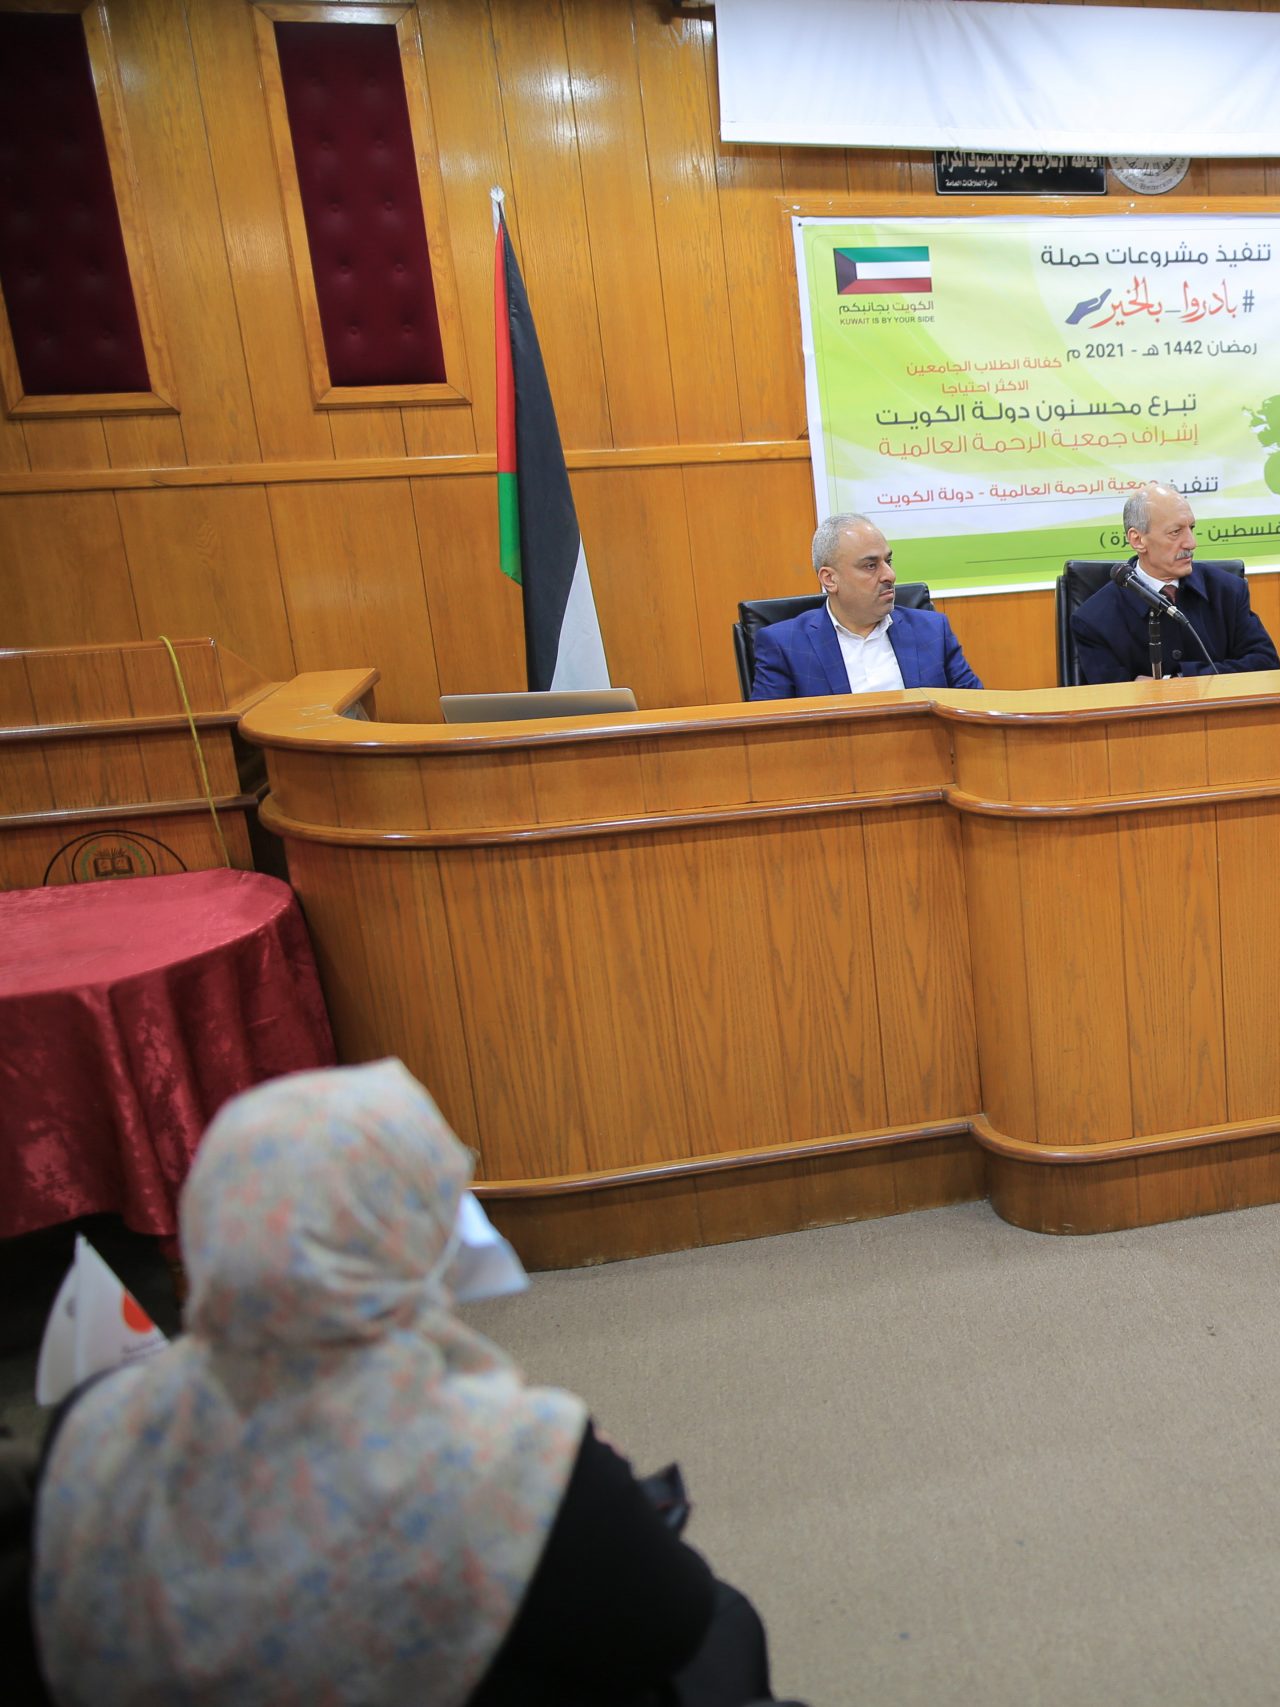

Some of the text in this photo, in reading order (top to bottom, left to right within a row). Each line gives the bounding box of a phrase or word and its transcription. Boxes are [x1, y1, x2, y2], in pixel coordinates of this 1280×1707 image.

[1041, 241, 1272, 268] تنفيذ مشروعات حملة
[839, 300, 934, 315] الكويت بجانبكم
[840, 318, 870, 326] KUWAIT
[893, 316, 915, 324] YOUR
[1066, 348, 1081, 362] م
[1085, 343, 1125, 359] 2021
[1163, 340, 1203, 356] 1442
[1207, 340, 1258, 357] رمضان
[906, 357, 1062, 376] كفالة الطلاب الجامعين
[941, 382, 990, 395] احتياجا
[875, 394, 1198, 430] تبرع محسنون دولة الكويت
[878, 421, 1199, 460] إشراف جمعية الرحمة العالمية
[989, 482, 1051, 501] العالمية
[1055, 478, 1104, 495] الرحمة
[876, 489, 935, 506] الكويت
[938, 487, 974, 504] دولة
